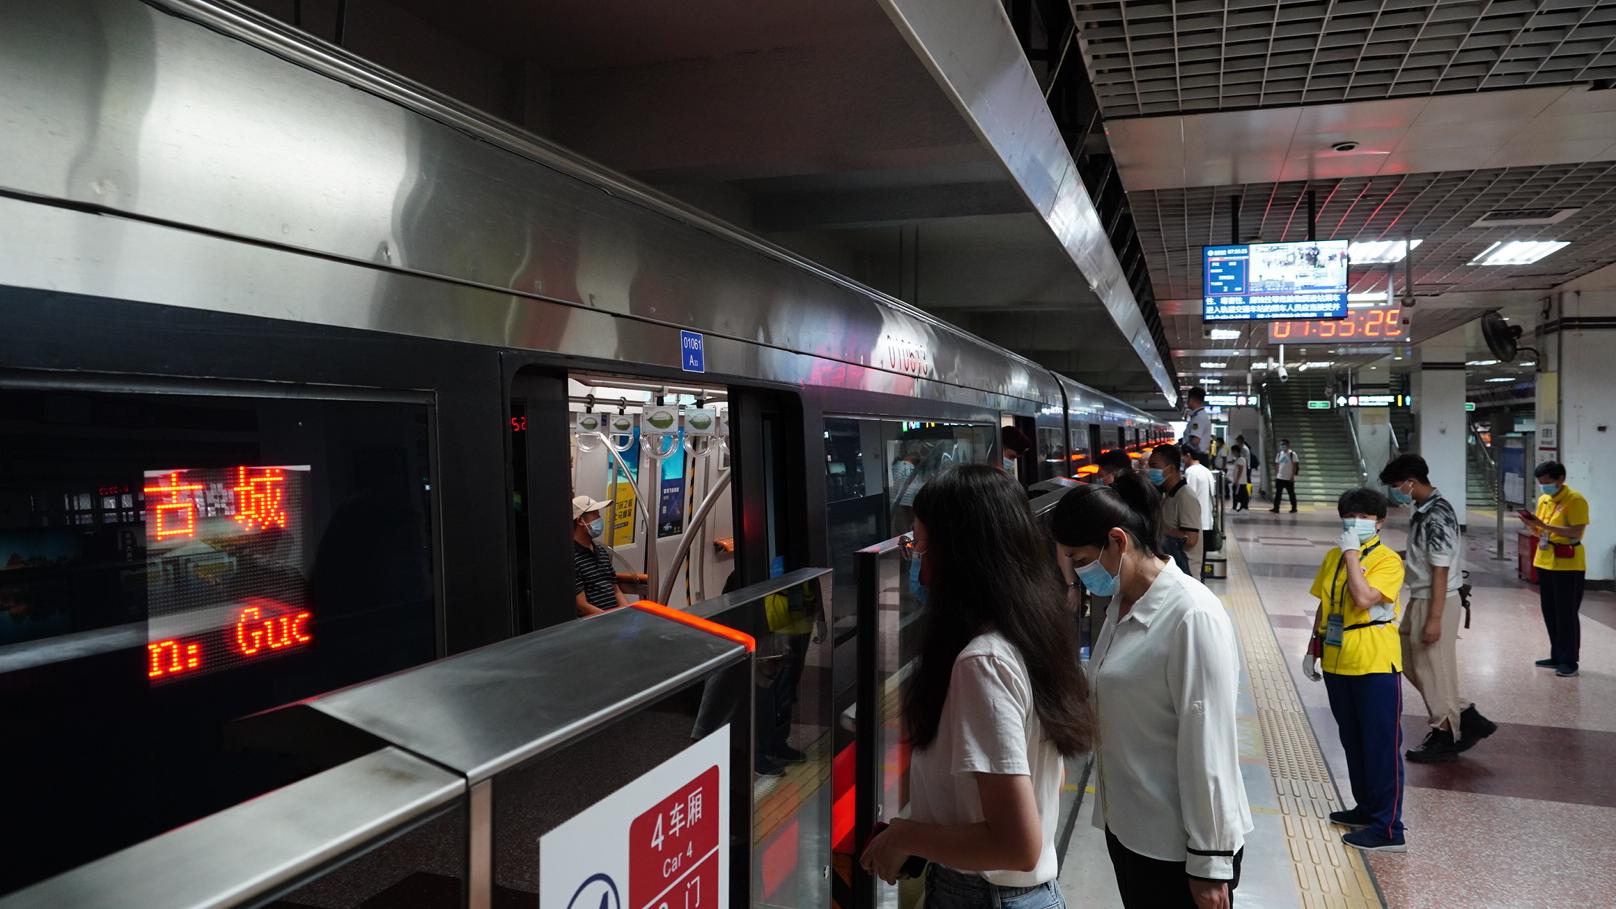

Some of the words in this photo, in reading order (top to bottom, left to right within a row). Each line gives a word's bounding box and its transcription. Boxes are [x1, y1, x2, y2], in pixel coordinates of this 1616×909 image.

[683, 336, 701, 351] 01061
[143, 466, 287, 540] 古城
[662, 852, 683, 878] Car
[686, 841, 693, 858] 4
